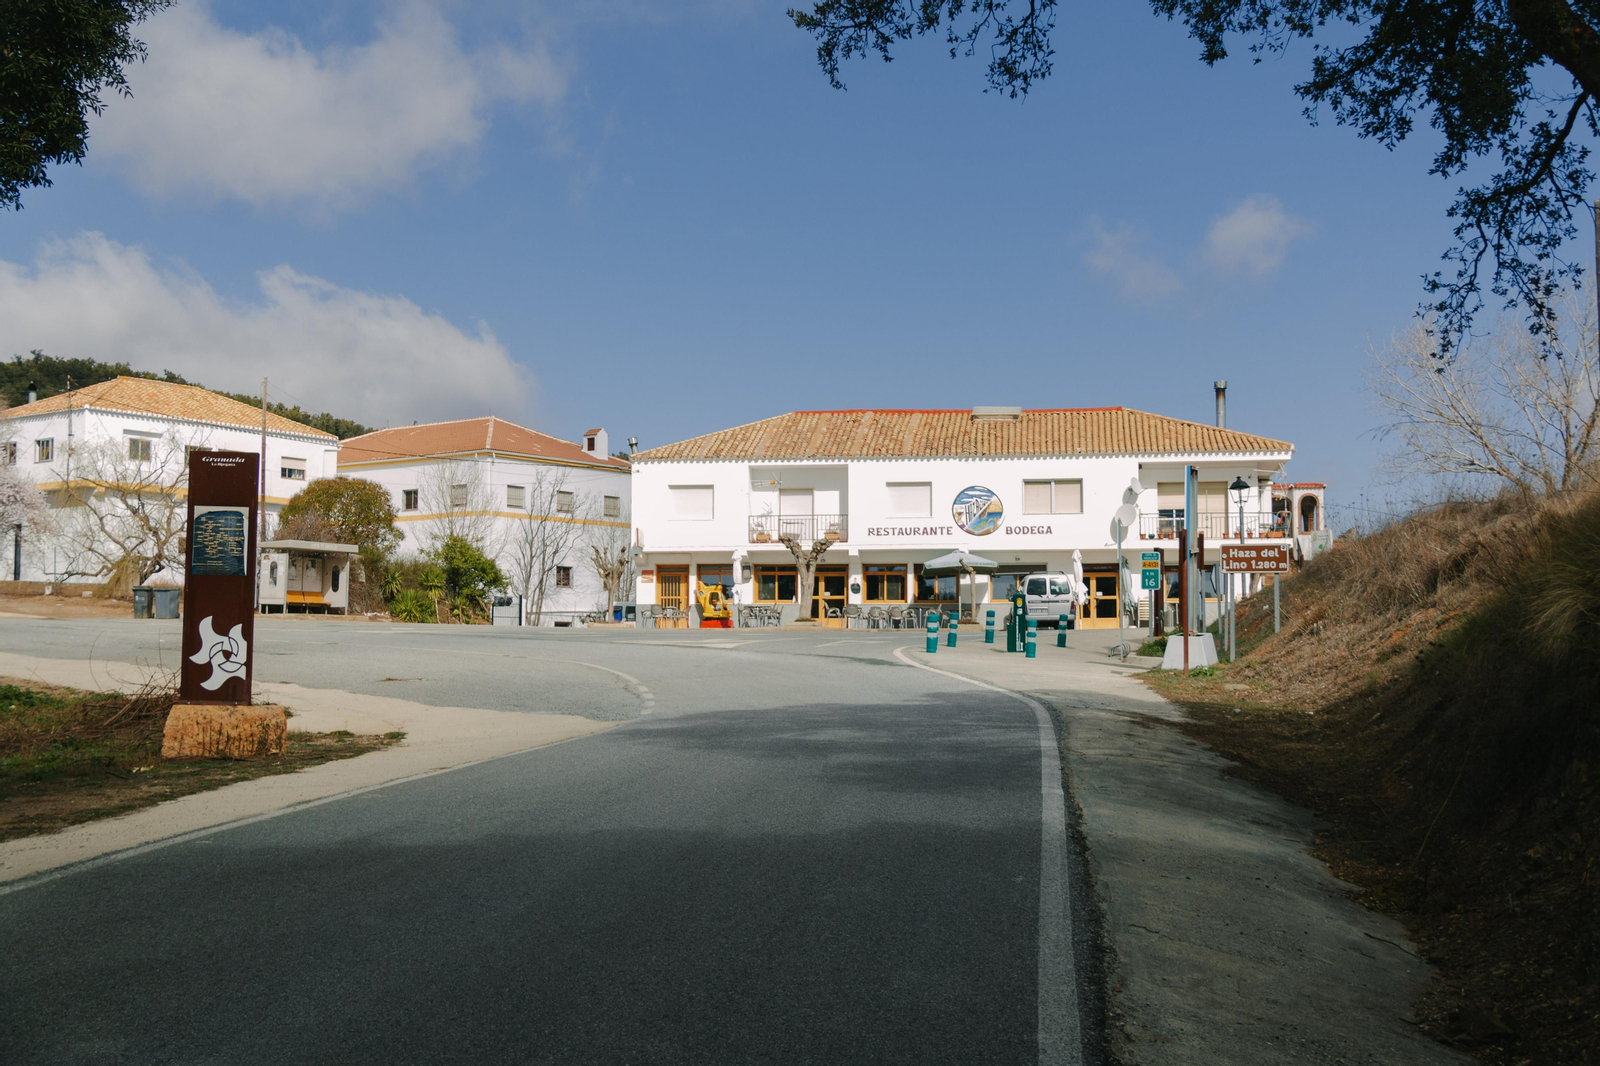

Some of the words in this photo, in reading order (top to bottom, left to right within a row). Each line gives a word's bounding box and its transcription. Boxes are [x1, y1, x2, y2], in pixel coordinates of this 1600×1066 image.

[867, 526, 953, 536] RESTAURANTE
[1005, 525, 1053, 535] BODEGA
[1229, 548, 1257, 558] Haza
[1260, 547, 1280, 558] del
[1222, 560, 1247, 569] Lino
[1250, 559, 1277, 569] 1.280
[1145, 578, 1156, 587] 16
